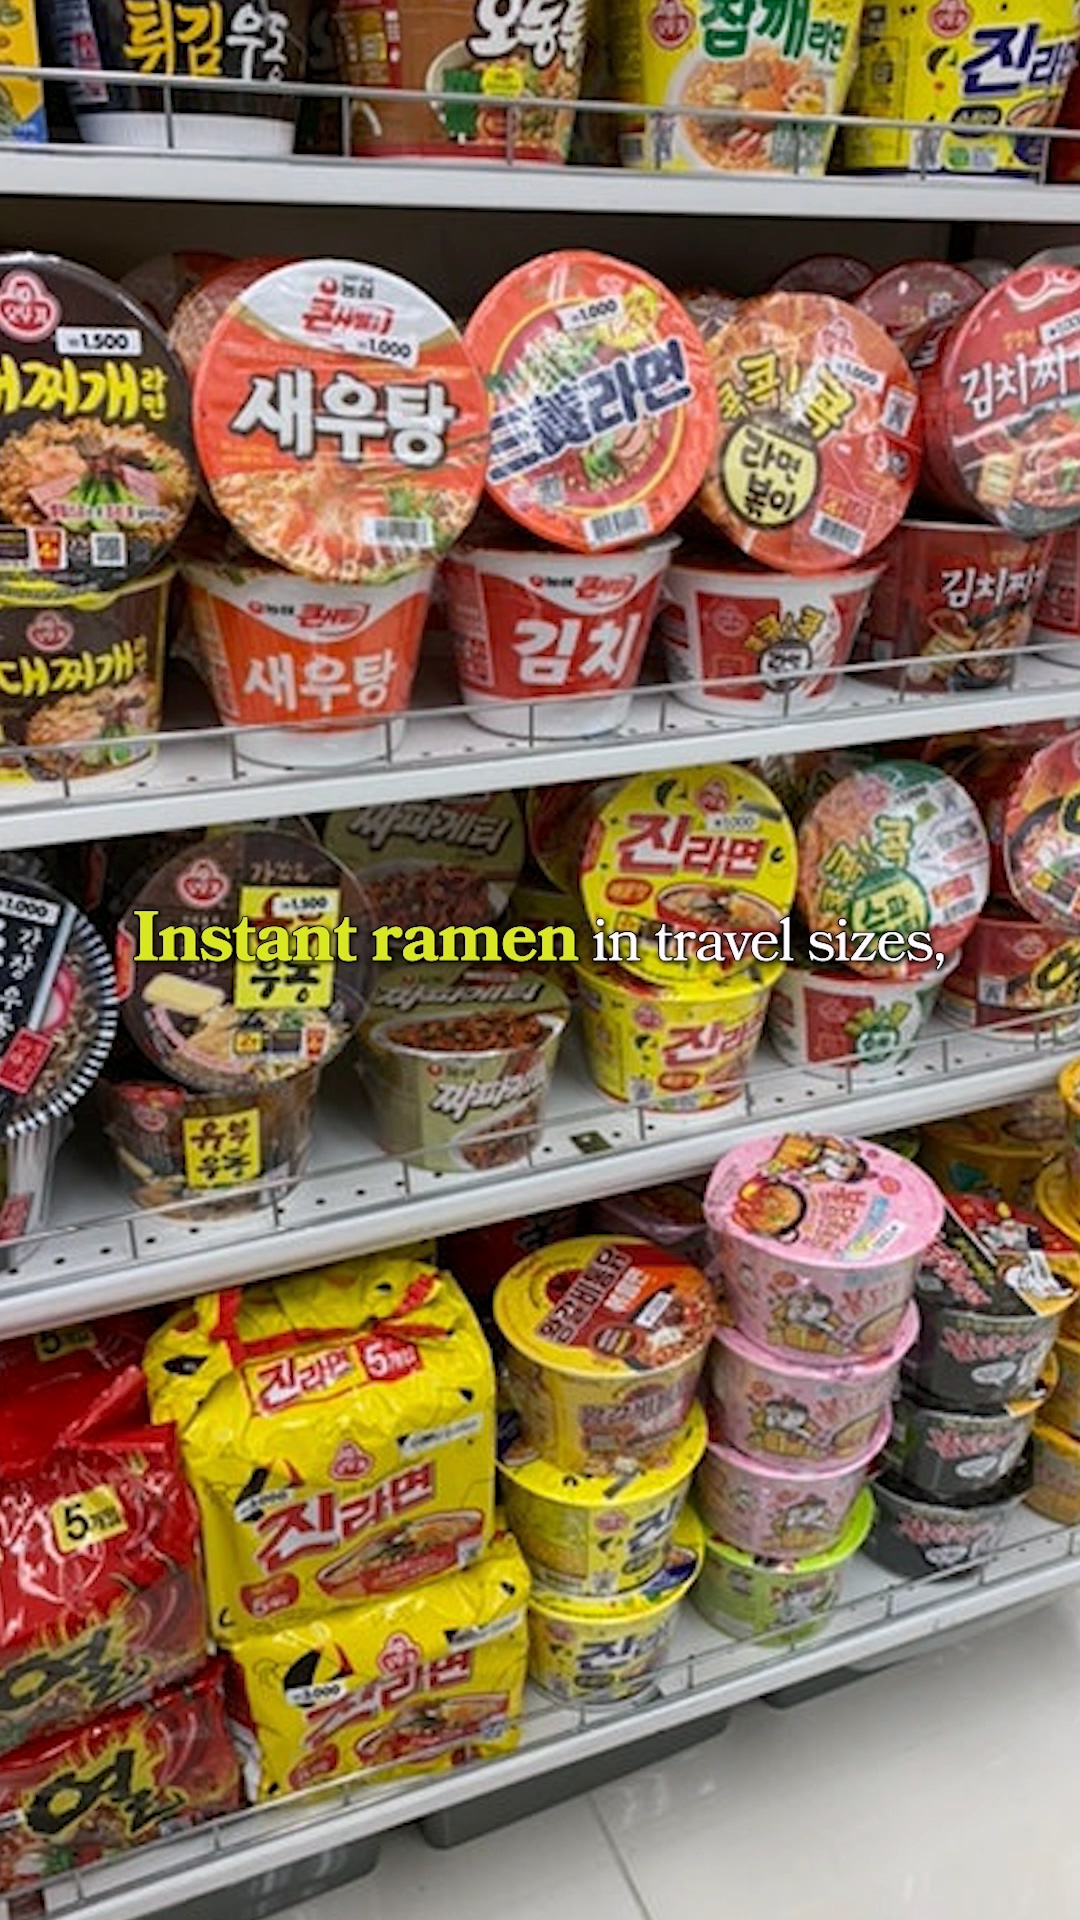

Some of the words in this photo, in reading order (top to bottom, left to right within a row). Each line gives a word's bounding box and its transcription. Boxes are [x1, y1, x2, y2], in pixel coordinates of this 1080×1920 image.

[0, 354, 139, 419] 찌개
[229, 368, 460, 467] 새우탕
[959, 343, 1080, 421] 김치찌
[244, 649, 397, 713] 새우탕
[512, 612, 642, 686] 김치
[617, 813, 769, 880] 진라면
[256, 1349, 351, 1416] 진라면
[256, 1462, 436, 1573] 진라면
[305, 1649, 472, 1748] 진라면
